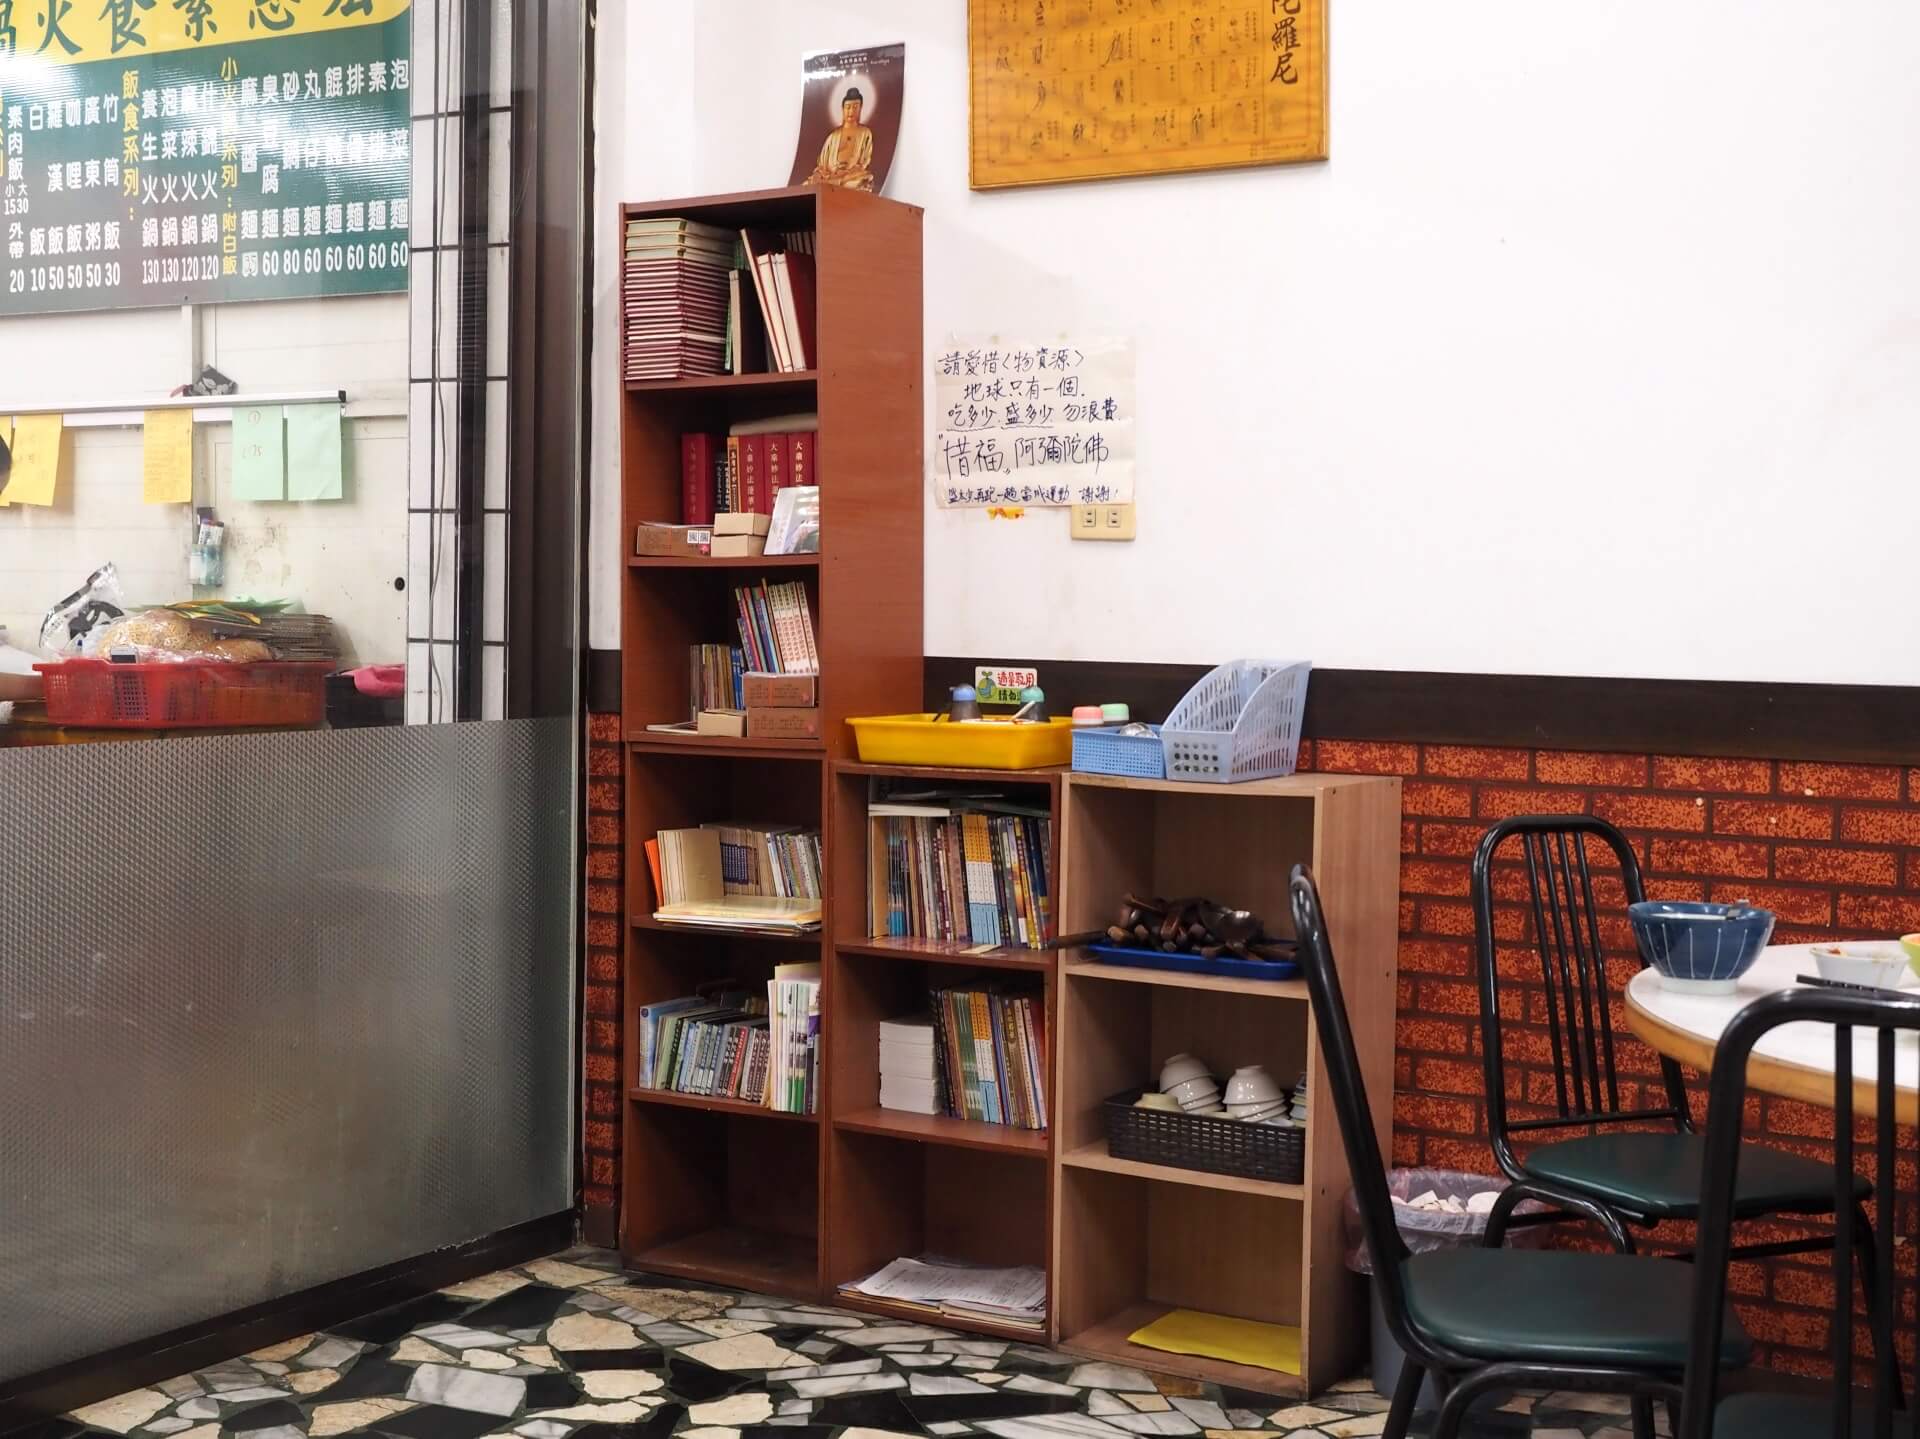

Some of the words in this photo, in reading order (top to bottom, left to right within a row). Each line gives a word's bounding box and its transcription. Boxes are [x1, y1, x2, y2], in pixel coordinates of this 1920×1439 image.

[262, 250, 279, 276] 60
[283, 249, 300, 275] 80
[304, 247, 321, 273] 60
[325, 246, 343, 272] 60
[347, 244, 364, 270] 60
[368, 243, 386, 269] 60
[391, 241, 409, 267] 60
[31, 267, 46, 291] 10
[49, 266, 64, 290] 50
[67, 264, 83, 288] 50
[86, 263, 102, 287] 50
[105, 262, 121, 286] 30
[142, 259, 159, 284] 130
[162, 257, 179, 282] 130
[182, 255, 198, 282] 120
[201, 254, 219, 280] 120
[9, 269, 25, 293] 20
[998, 689, 1021, 701] 請勿
